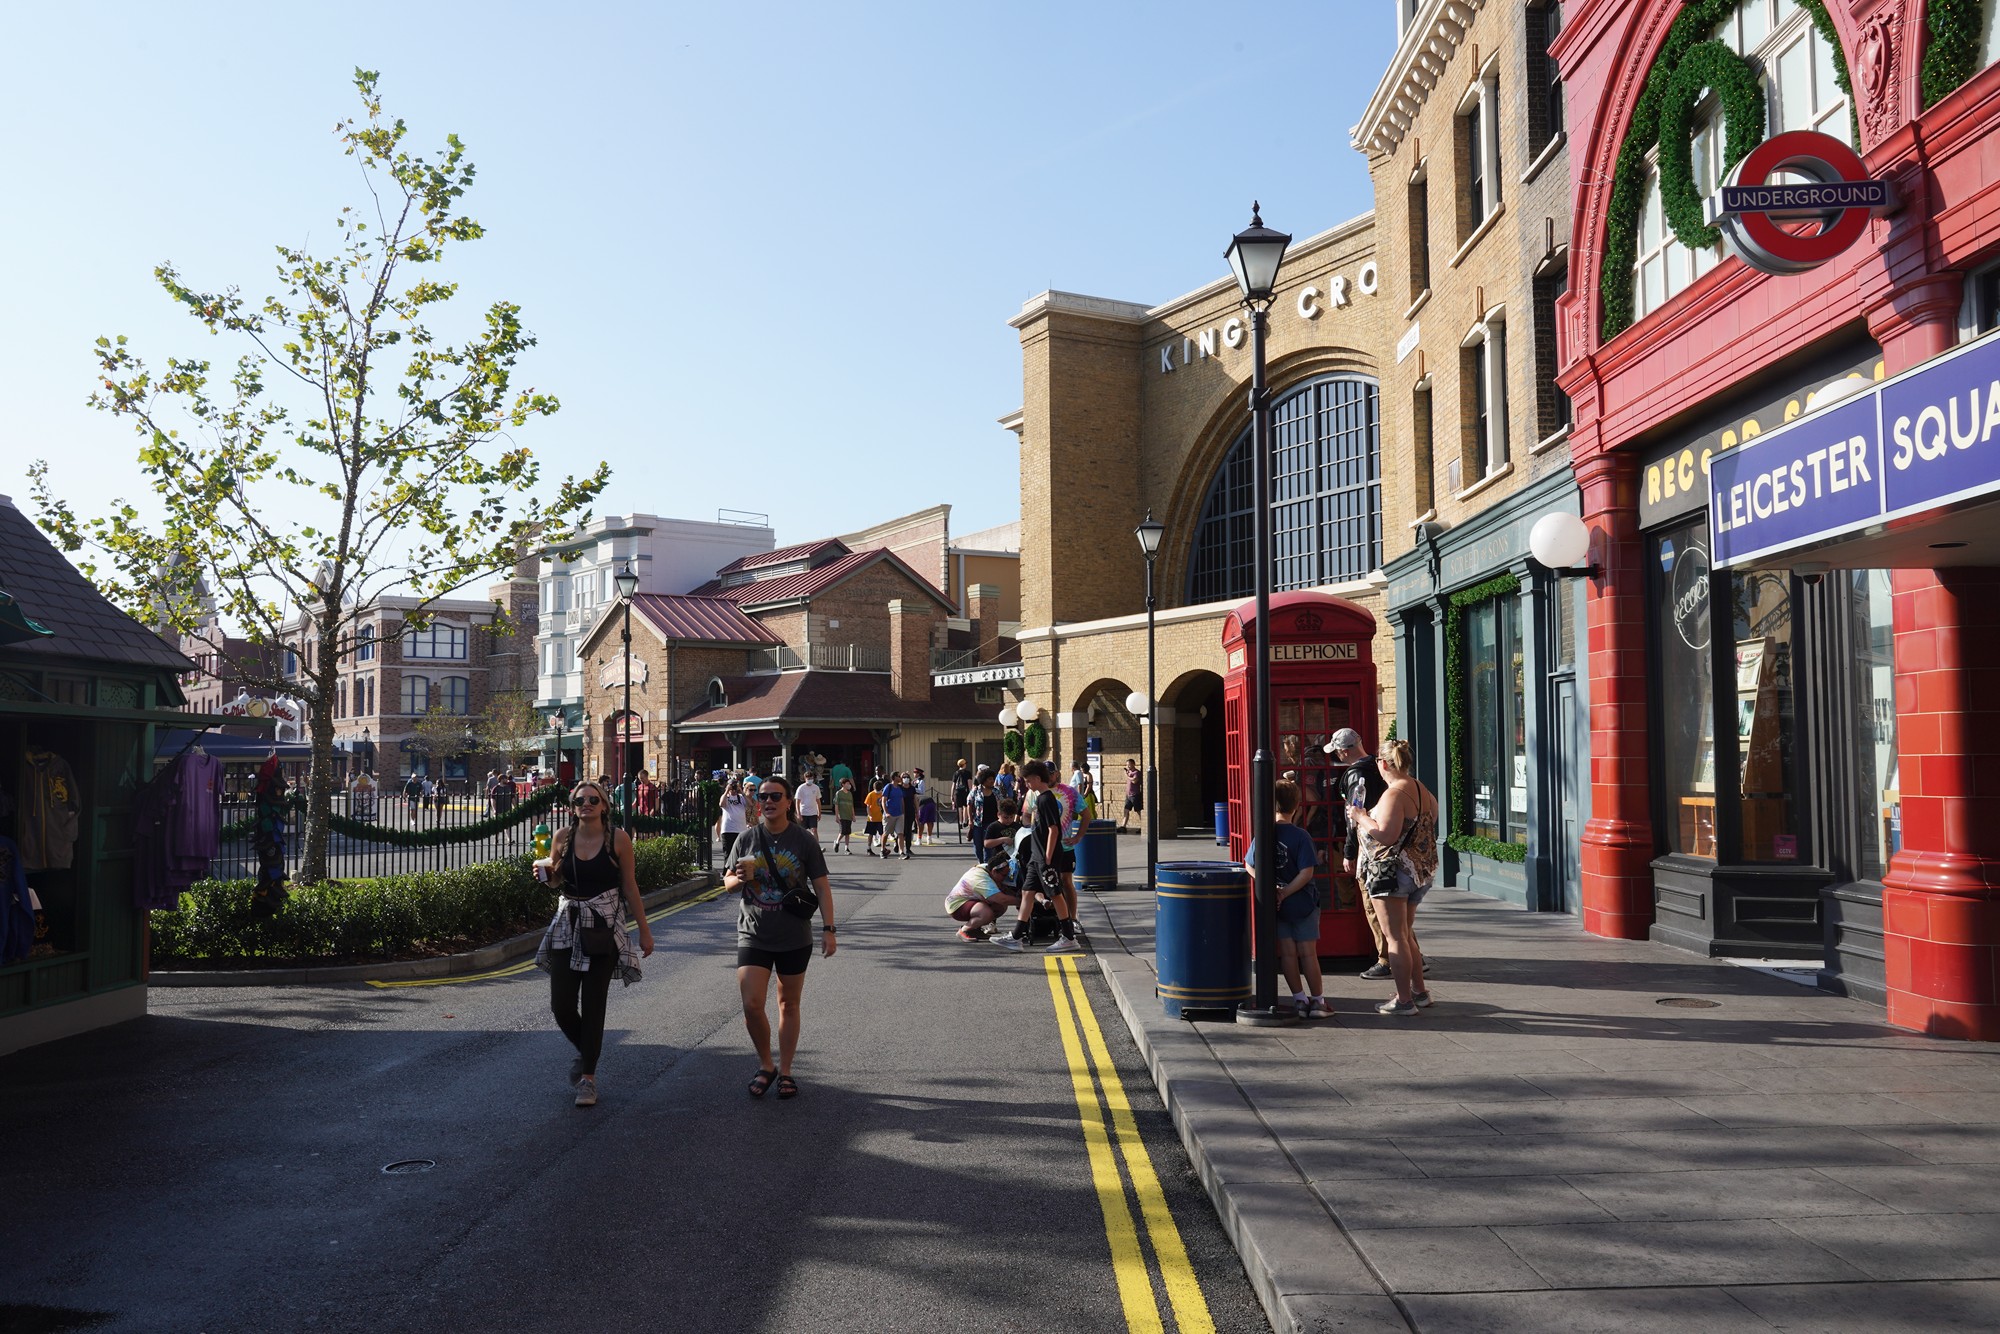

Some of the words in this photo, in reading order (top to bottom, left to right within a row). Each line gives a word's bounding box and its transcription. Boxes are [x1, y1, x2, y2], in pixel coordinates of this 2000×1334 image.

[1727, 186, 1882, 208] UNDERGROUND
[1716, 435, 1872, 534] LEICESTER
[1488, 533, 1509, 560] SONS
[1269, 643, 1356, 660] ELEPHONE
[981, 667, 1021, 682] CROSS
